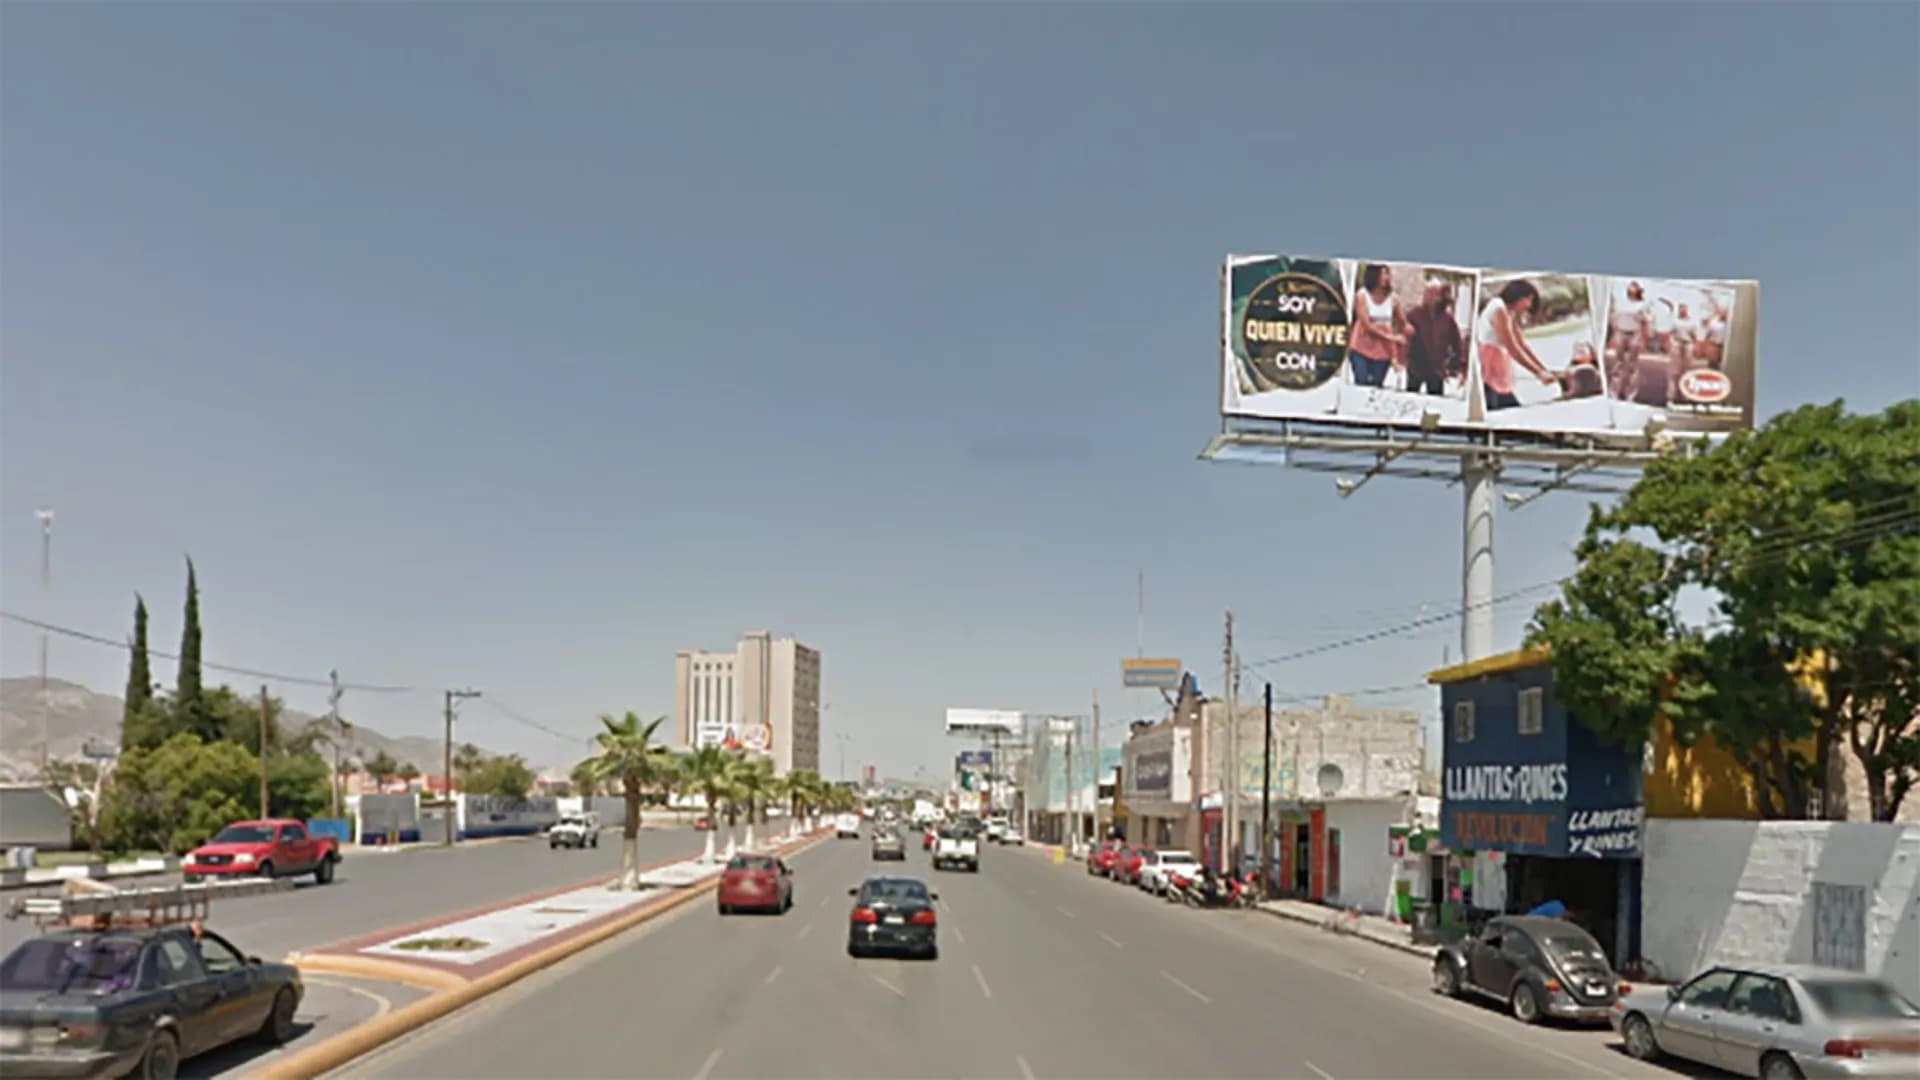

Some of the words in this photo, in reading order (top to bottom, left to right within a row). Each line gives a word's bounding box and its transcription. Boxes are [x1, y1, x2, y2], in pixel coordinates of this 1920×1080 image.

[1278, 295, 1316, 314] SOY
[1246, 319, 1300, 342] QUIEN
[1303, 323, 1346, 346] VIVE
[1277, 353, 1316, 370] CON
[1446, 766, 1513, 800] LLANTAS
[1520, 763, 1567, 804] RINES
[1568, 806, 1645, 831] LLANTAS
